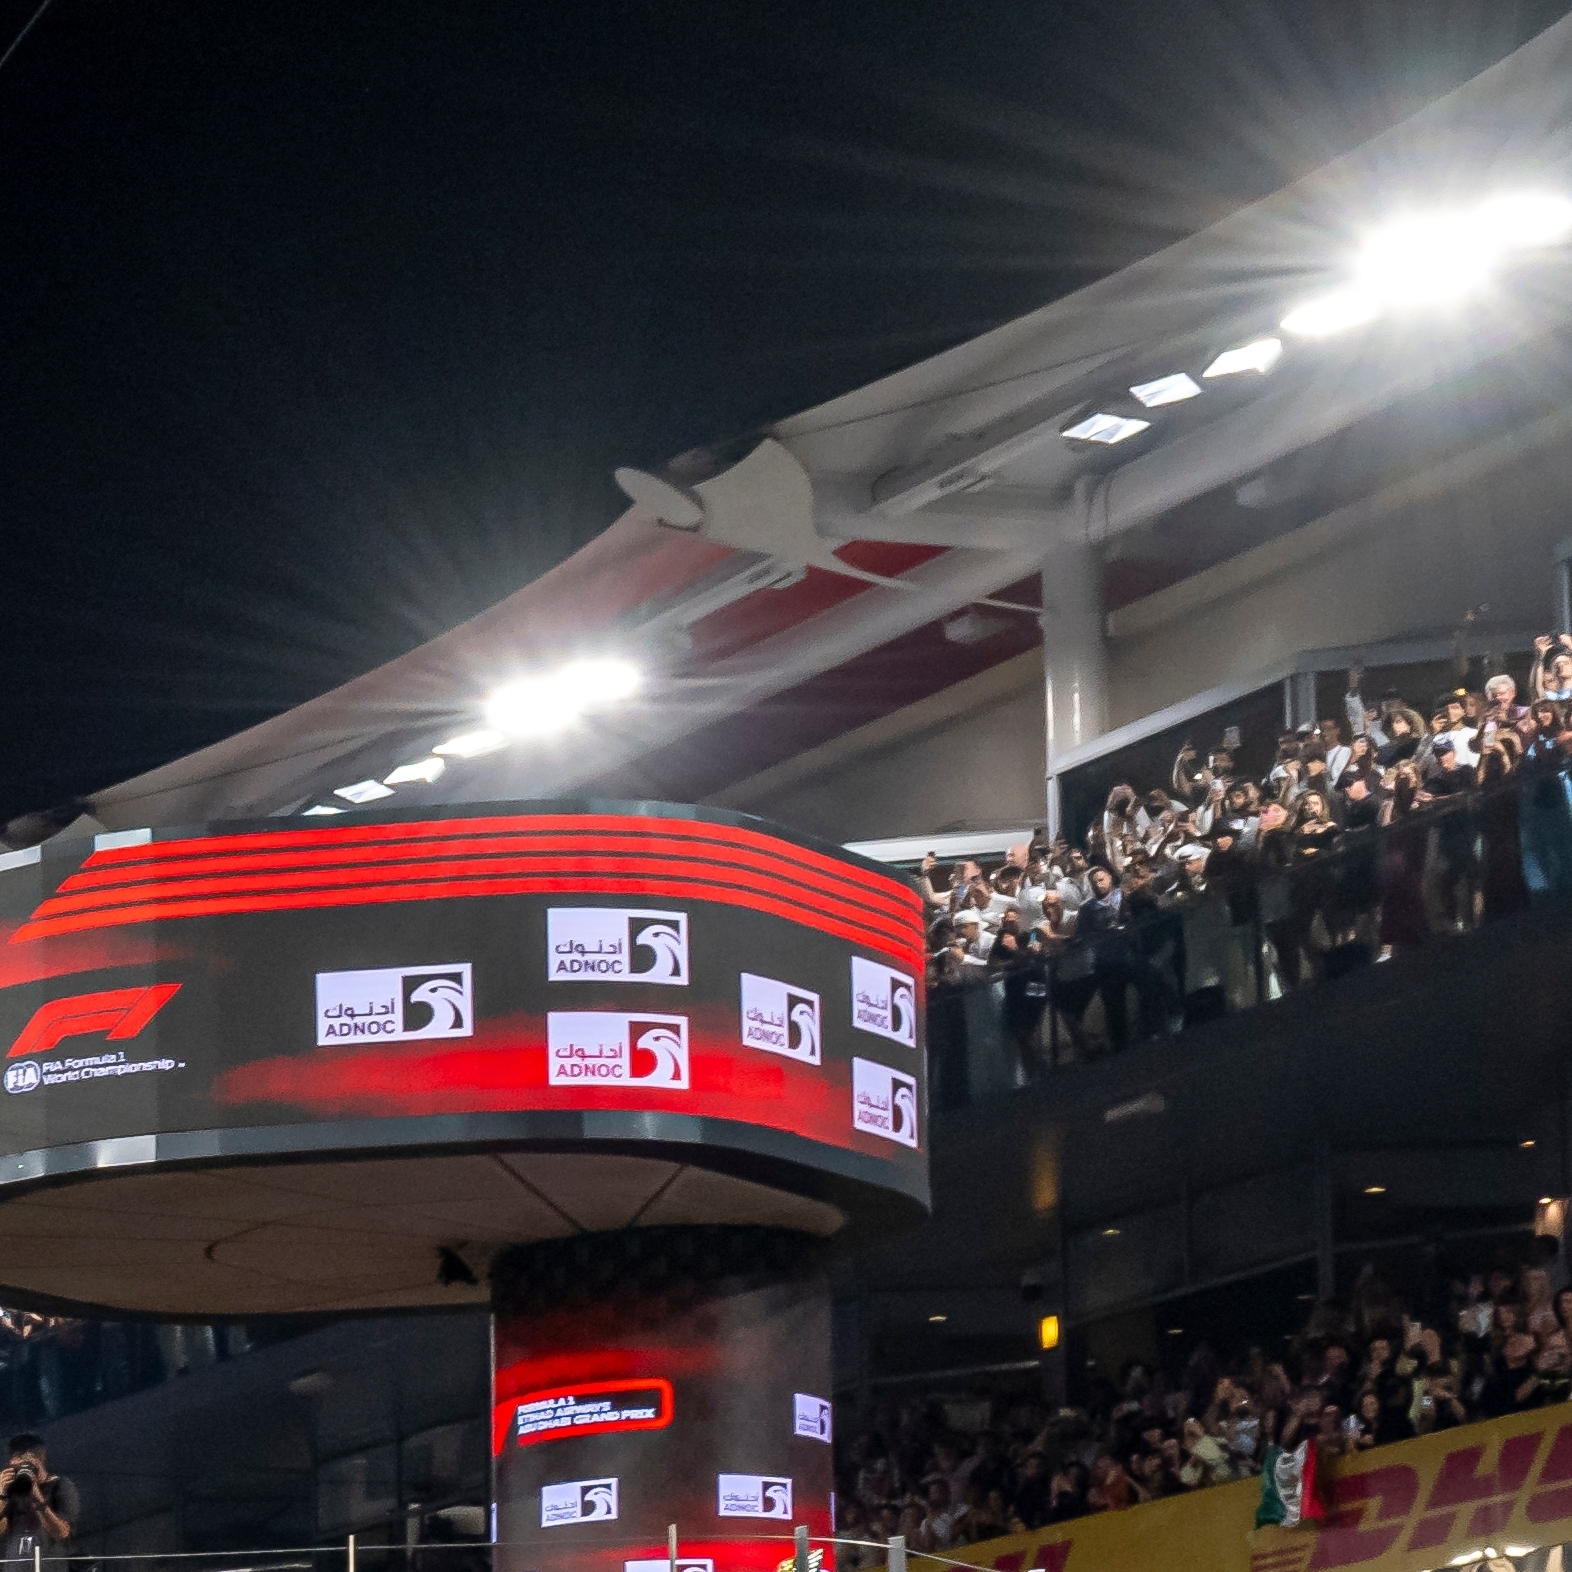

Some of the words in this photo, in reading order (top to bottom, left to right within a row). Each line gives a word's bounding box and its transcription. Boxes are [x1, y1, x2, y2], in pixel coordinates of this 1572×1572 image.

[555, 959, 624, 975] ADNOC
[324, 1019, 397, 1038] ADNOC
[67, 1053, 115, 1070] Formula
[6, 1067, 40, 1090] FIA
[42, 1070, 81, 1086] World
[82, 1057, 176, 1080] Championship
[555, 1063, 624, 1079] ADNOC
